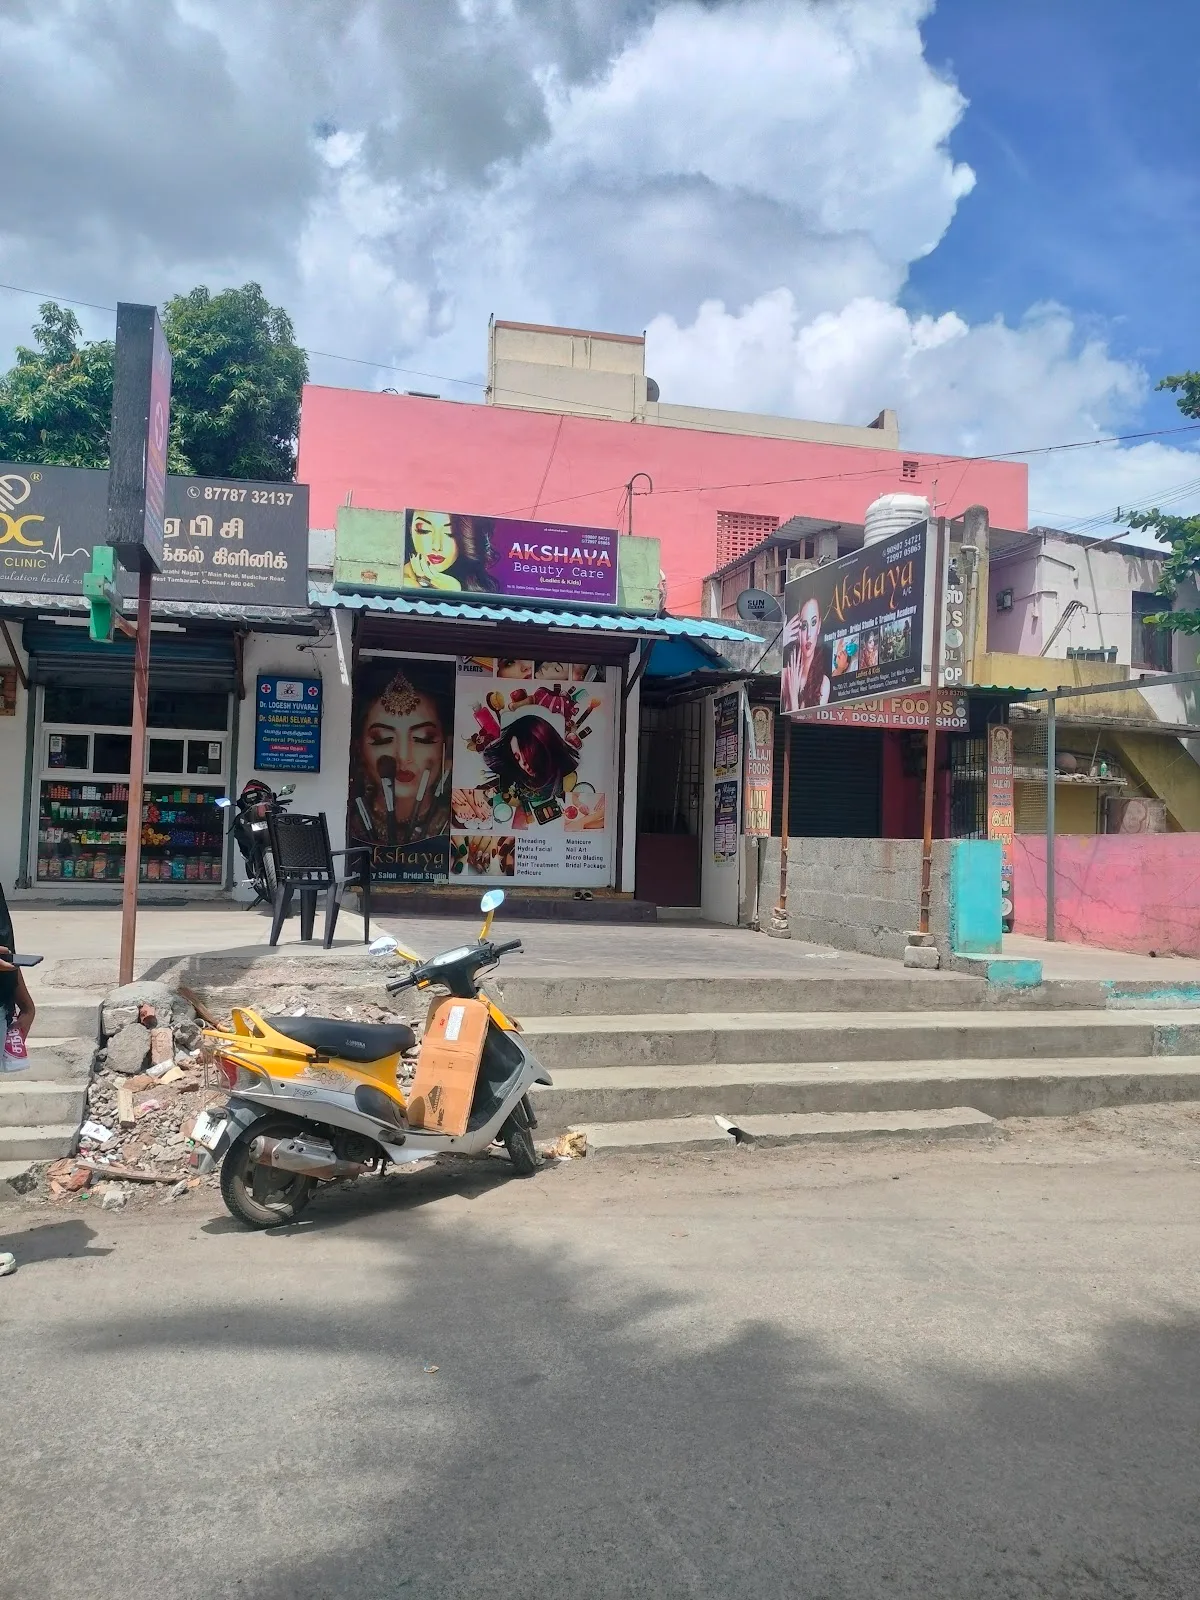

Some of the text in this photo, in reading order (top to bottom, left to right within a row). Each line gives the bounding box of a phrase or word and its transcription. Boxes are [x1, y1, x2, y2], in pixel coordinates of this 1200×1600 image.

[204, 486, 294, 506] 87787 32137
[189, 514, 213, 537] பி
[220, 517, 244, 539] சி
[4, 557, 47, 568] CLINIC
[508, 542, 612, 568] AKSHAYA
[513, 561, 604, 579] Beauty Care
[823, 561, 913, 622] Akshaya
[945, 666, 963, 681] OP
[268, 701, 292, 709] LOGESH
[816, 711, 848, 723] IDLY,
[852, 713, 889, 724] DOSAI
[935, 716, 968, 728] SHOP
[748, 748, 771, 761] BLAJI
[748, 762, 770, 775] FOODS
[750, 790, 768, 809] IDLY
[745, 810, 770, 830] DOSAI
[370, 847, 444, 872] kshaya
[378, 871, 397, 879] Salon
